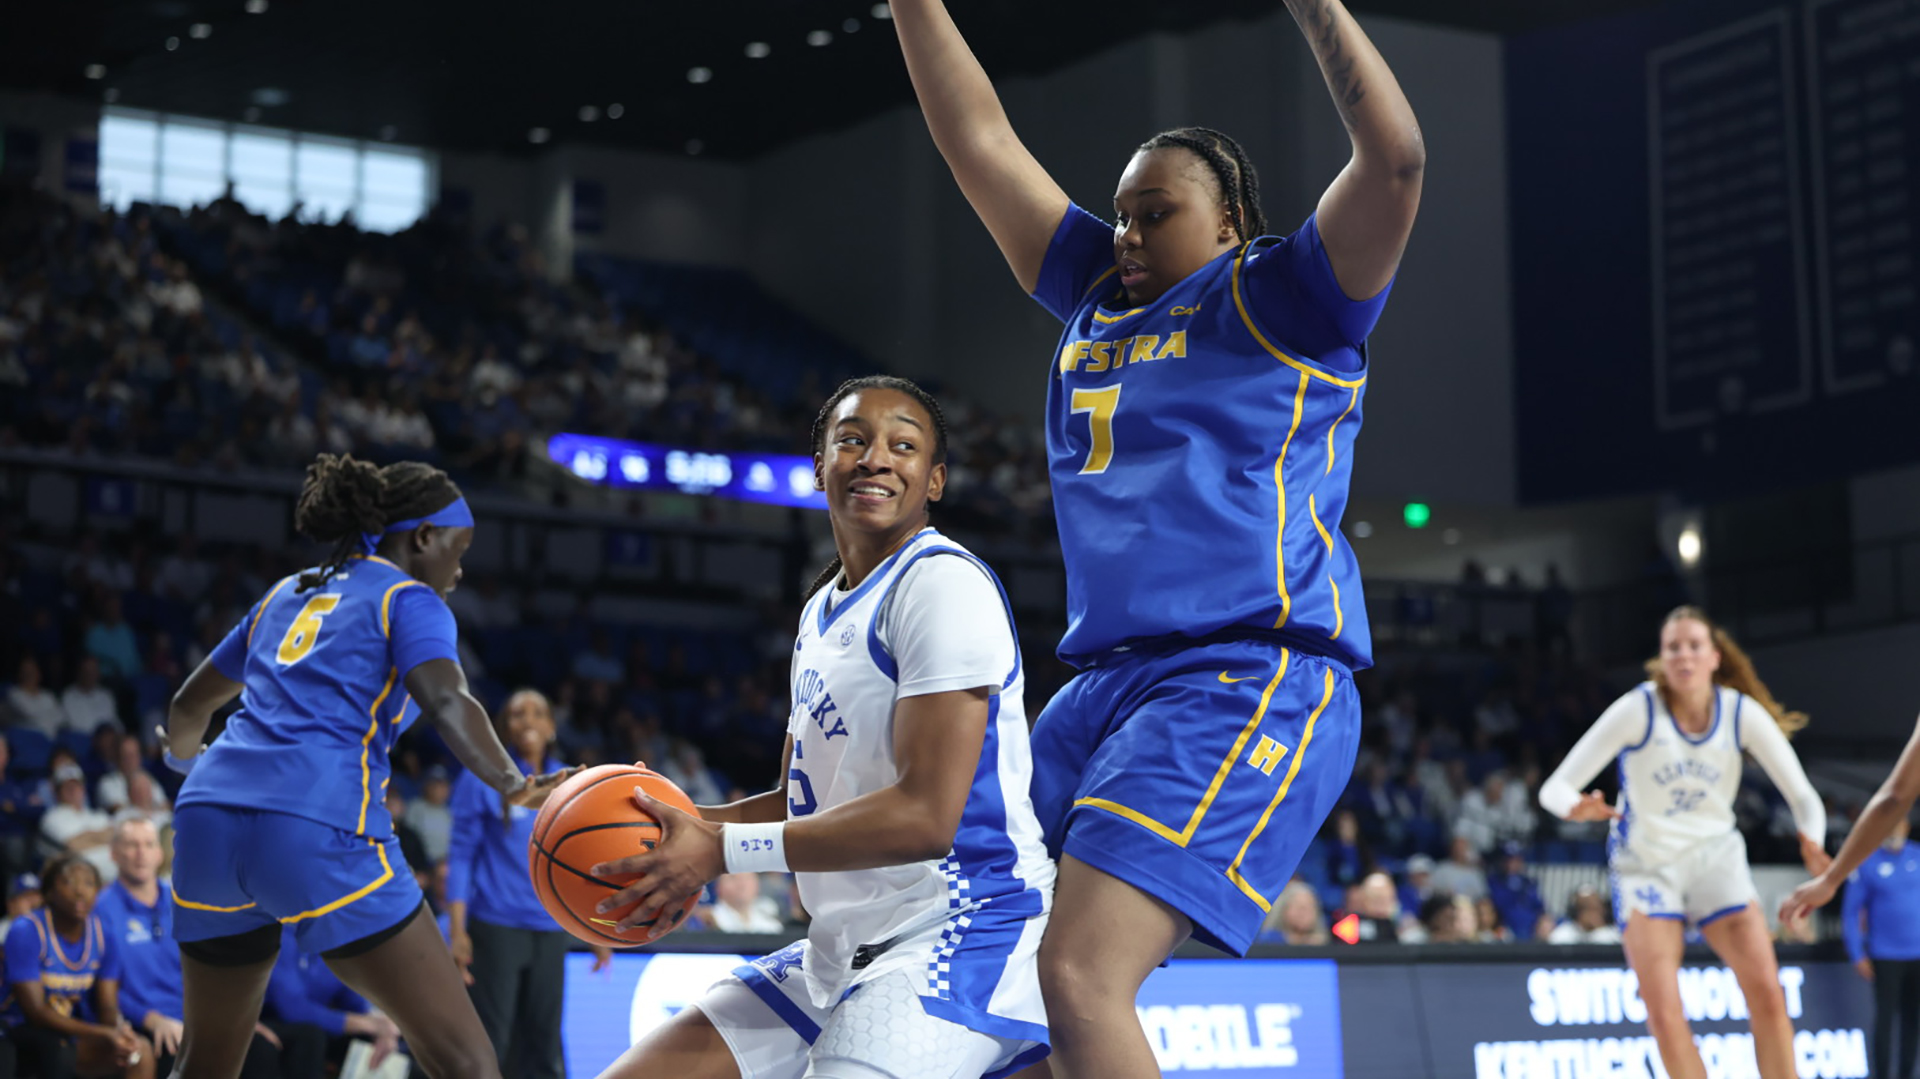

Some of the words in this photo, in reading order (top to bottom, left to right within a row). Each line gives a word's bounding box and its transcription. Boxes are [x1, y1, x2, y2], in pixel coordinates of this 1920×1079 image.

[1070, 383, 1122, 475] 7
[275, 593, 343, 667] 6
[1247, 733, 1289, 777] H
[1527, 967, 1649, 1026] SWITC
